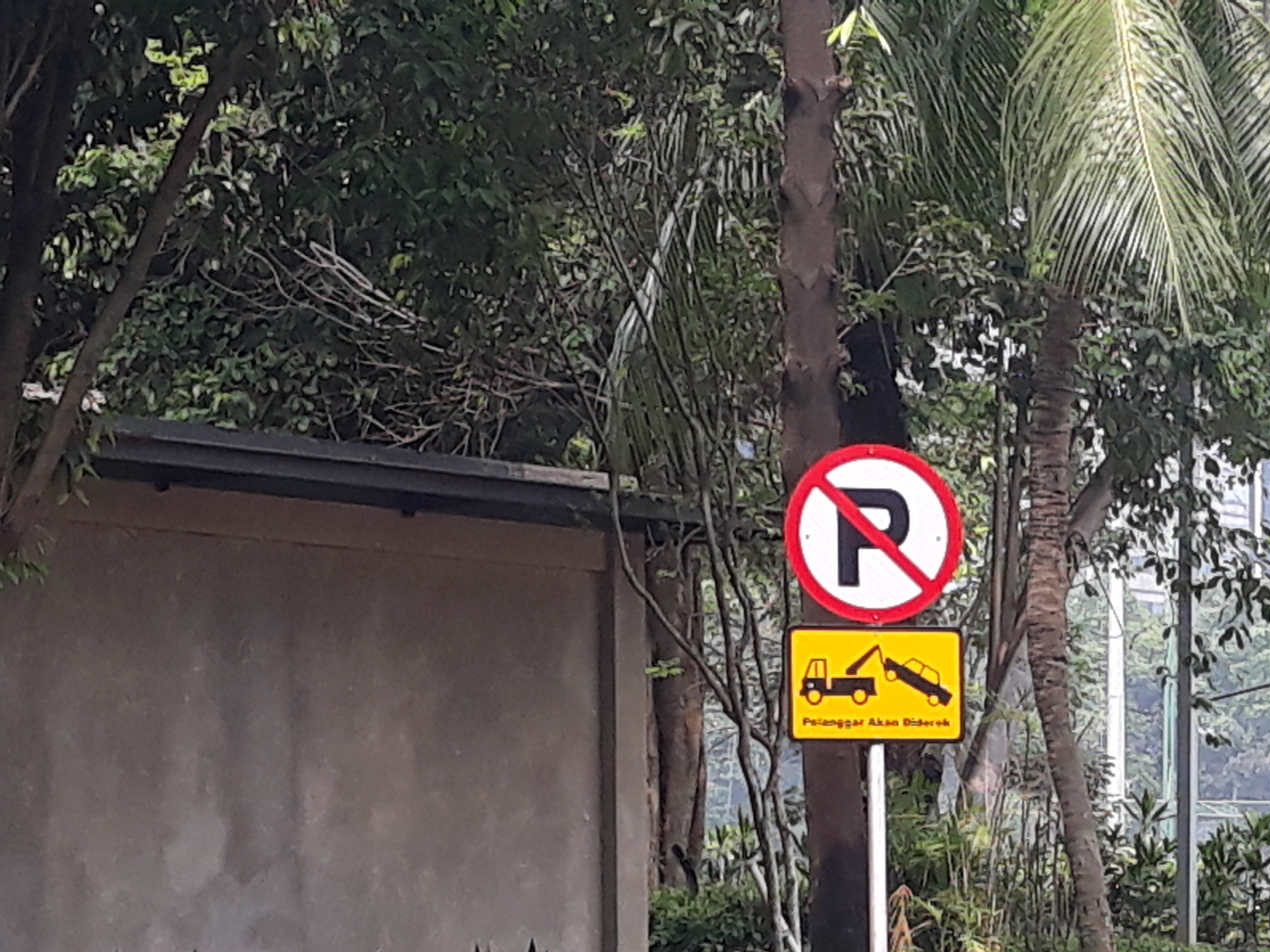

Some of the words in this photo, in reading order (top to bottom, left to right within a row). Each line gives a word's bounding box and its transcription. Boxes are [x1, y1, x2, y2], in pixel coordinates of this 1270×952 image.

[837, 488, 909, 586] P
[803, 717, 865, 729] Pelanggar
[868, 717, 899, 727] Akan
[903, 717, 950, 727] Diderek
